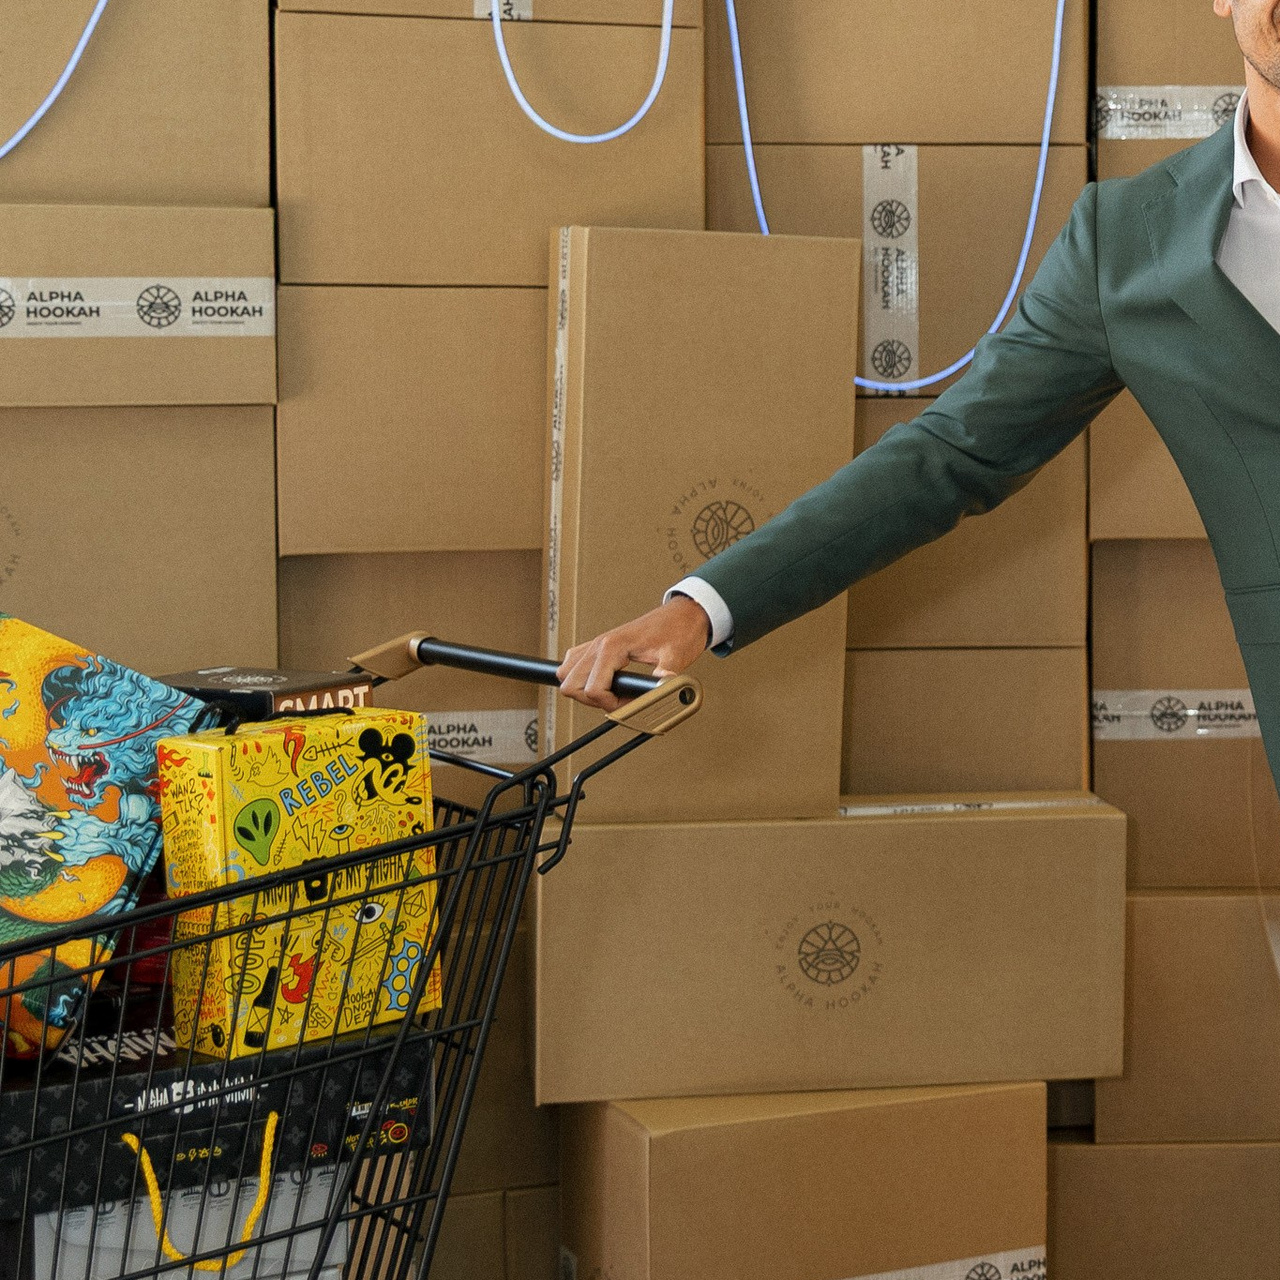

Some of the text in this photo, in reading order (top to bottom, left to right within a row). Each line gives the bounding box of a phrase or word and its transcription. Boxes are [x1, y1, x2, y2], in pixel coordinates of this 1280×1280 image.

[881, 247, 892, 310] HOOKAH
[27, 290, 84, 303] ALPHA
[192, 290, 247, 302] ALPHA
[26, 306, 100, 319] HOOKAH
[191, 305, 264, 318] HOOKAH
[1197, 700, 1245, 711] ALPHA
[427, 723, 479, 736] ALPHA
[428, 736, 494, 749] HOOKAH
[279, 752, 360, 817] REBEL
[137, 1085, 169, 1113] MSHA
